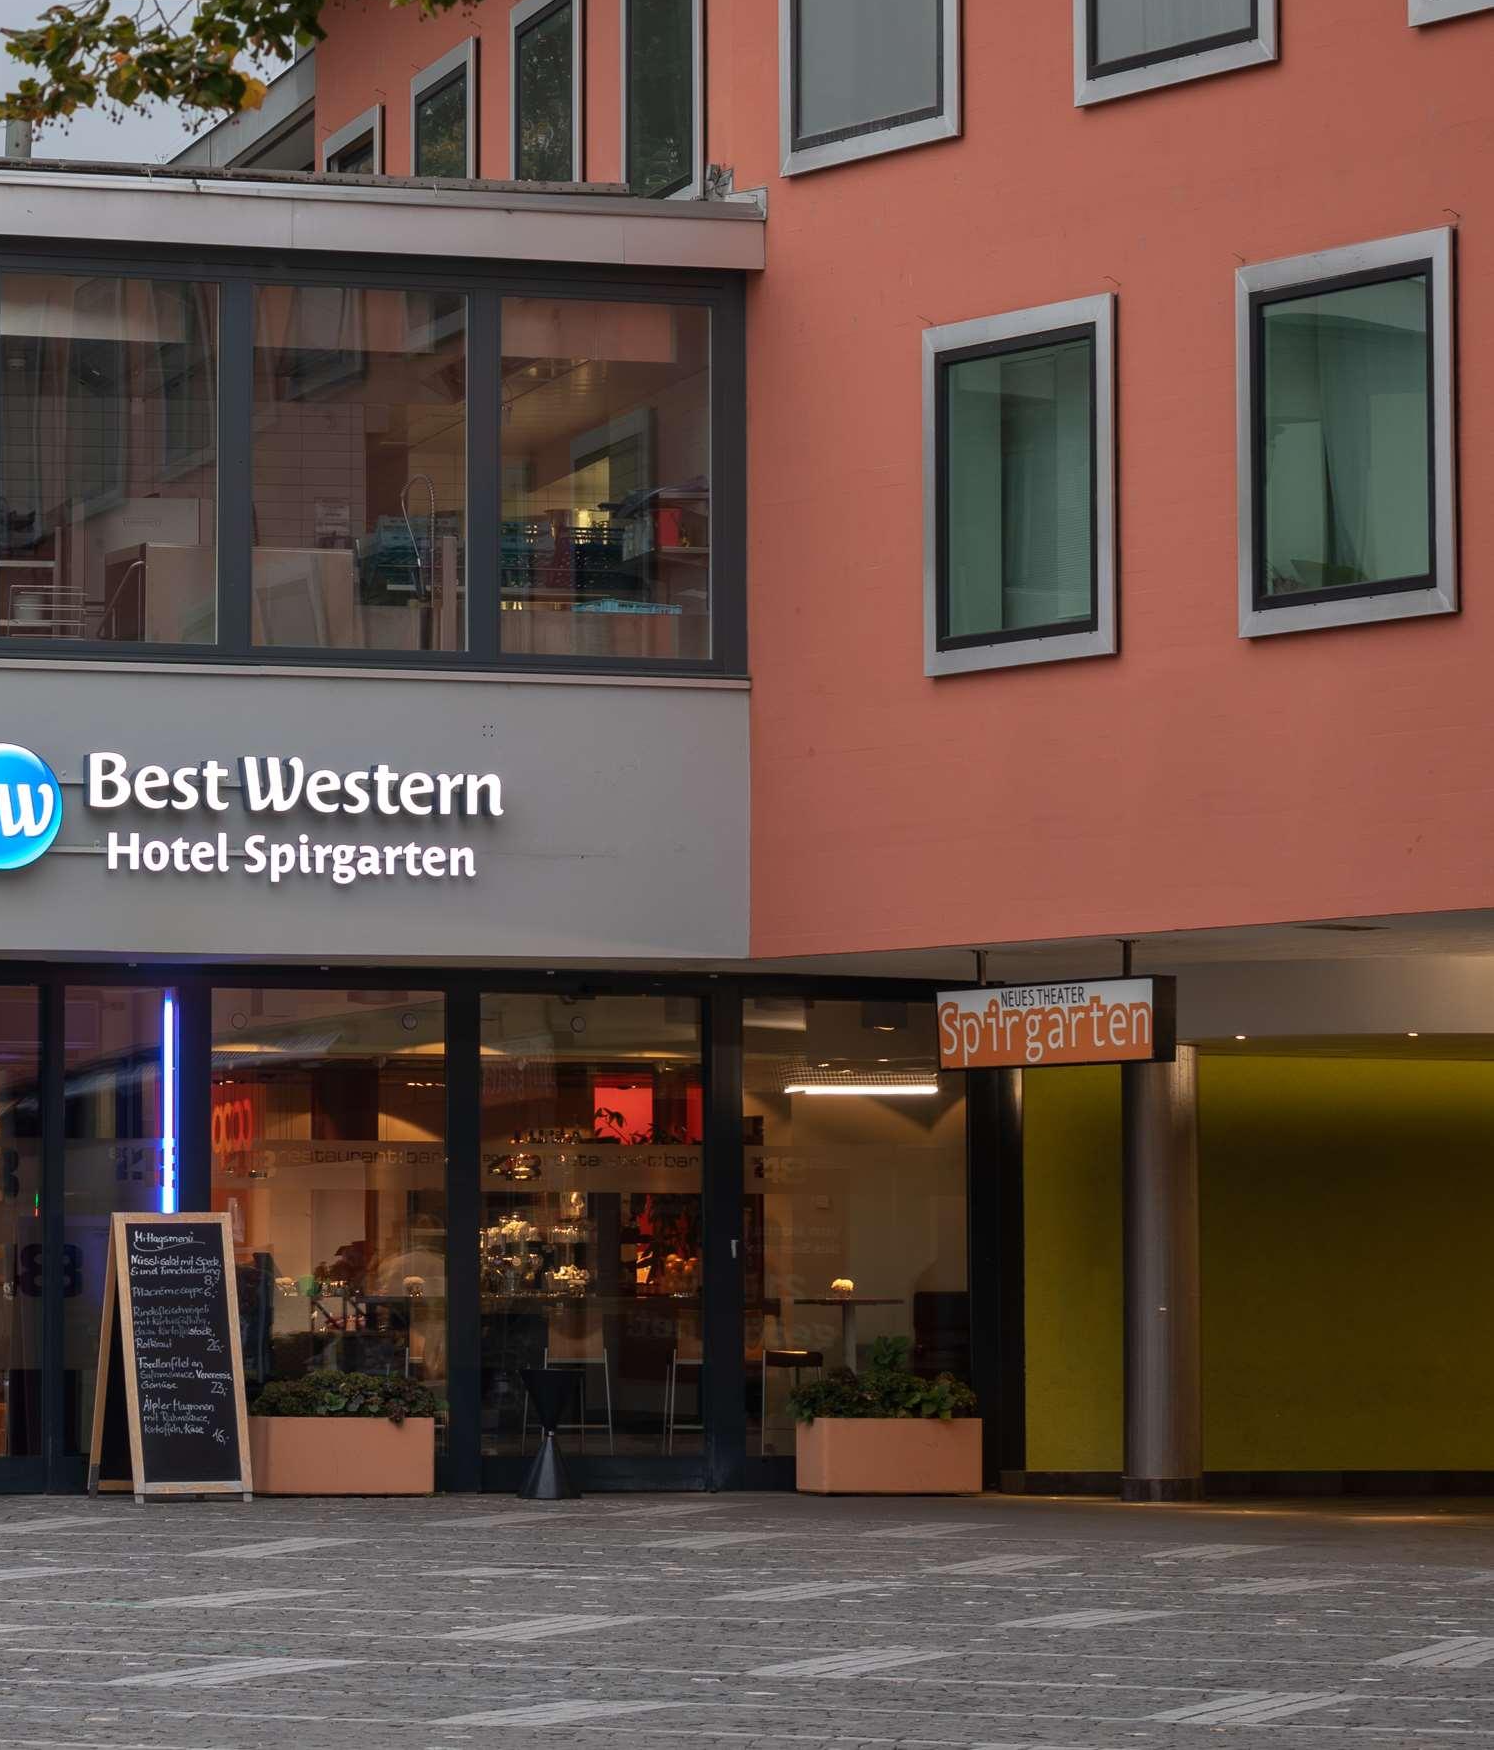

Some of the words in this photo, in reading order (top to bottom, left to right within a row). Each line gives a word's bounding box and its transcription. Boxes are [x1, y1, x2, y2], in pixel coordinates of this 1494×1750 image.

[87, 751, 230, 812] Best
[242, 755, 506, 818] Western
[106, 832, 229, 873] Hotel
[243, 834, 478, 885] Spirgarten
[1000, 988, 1034, 1008] NEUES
[1036, 985, 1086, 1005] THEATER
[940, 1000, 1151, 1066] Spirgarten
